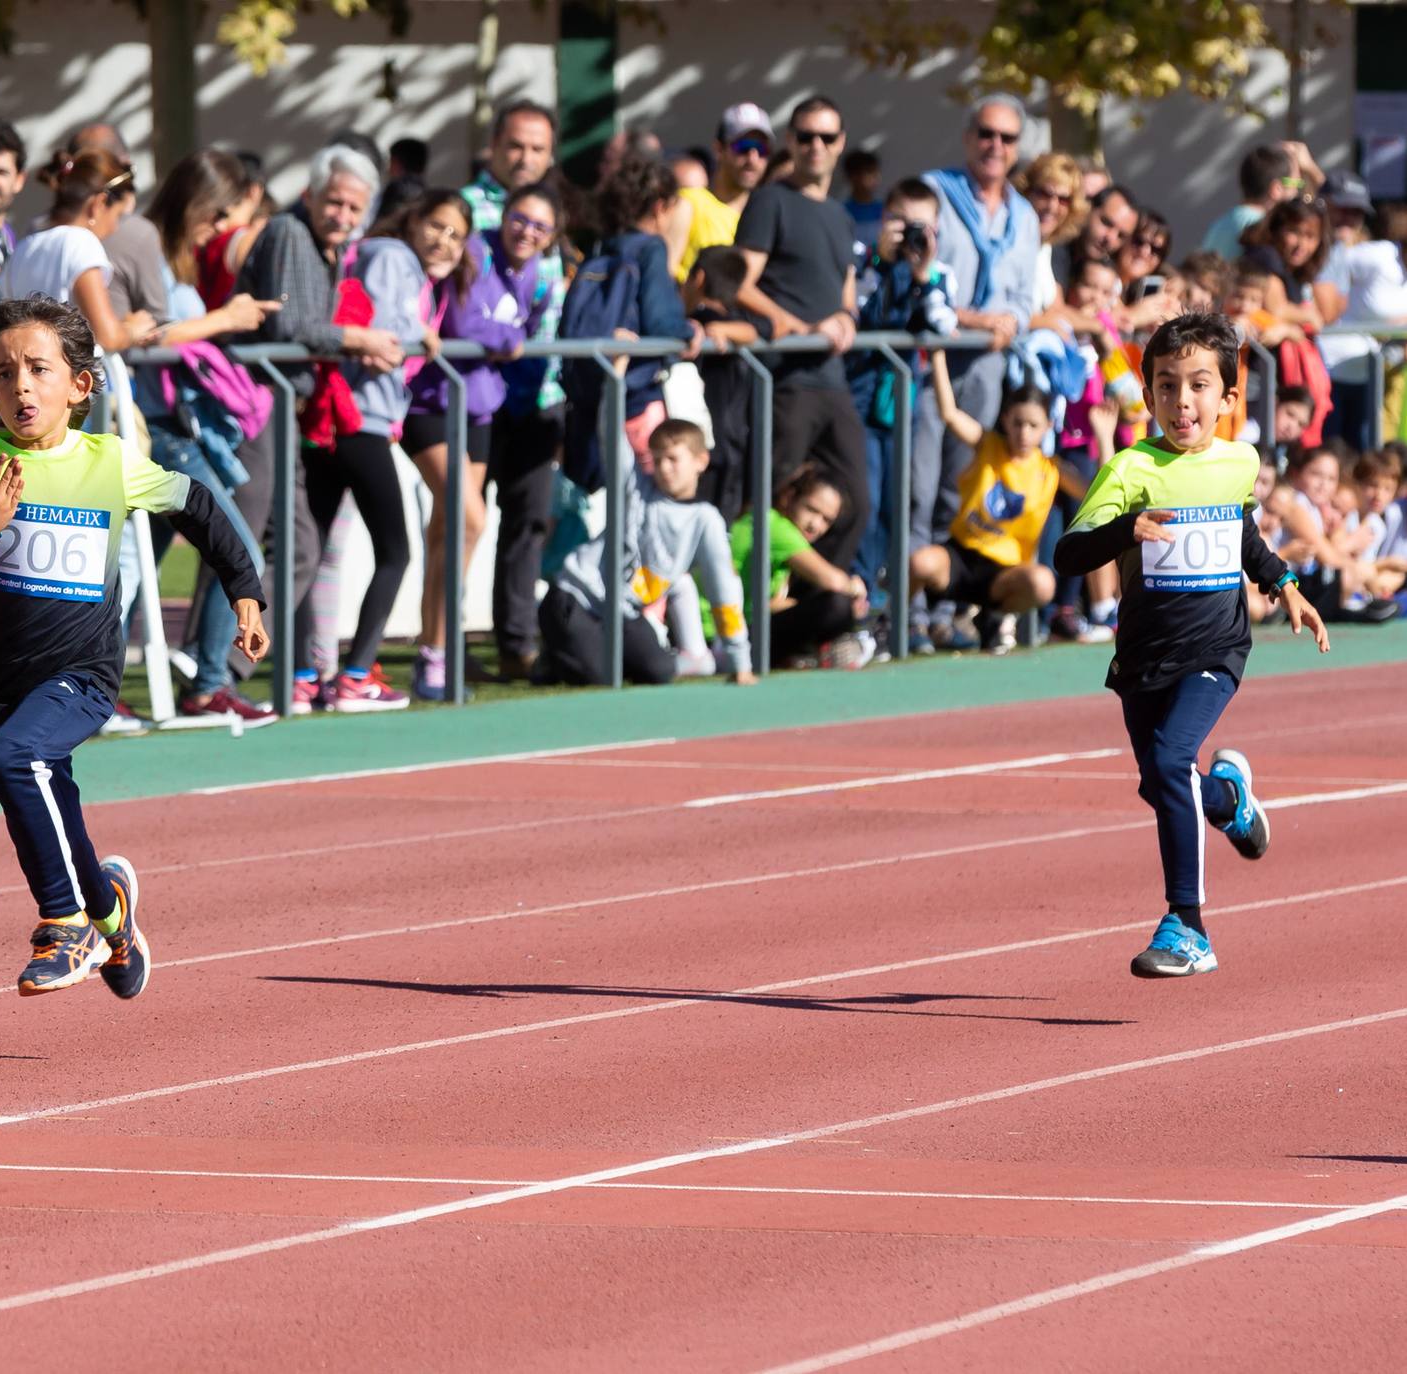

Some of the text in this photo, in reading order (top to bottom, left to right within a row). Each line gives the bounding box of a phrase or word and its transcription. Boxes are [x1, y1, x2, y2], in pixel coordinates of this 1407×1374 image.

[25, 506, 102, 526] HEMAFIX
[1177, 506, 1238, 522] HEMAFIX
[1154, 528, 1231, 570] 205
[22, 582, 62, 594] Logroñesa
[63, 586, 74, 595] de
[1156, 579, 1182, 587] Central
